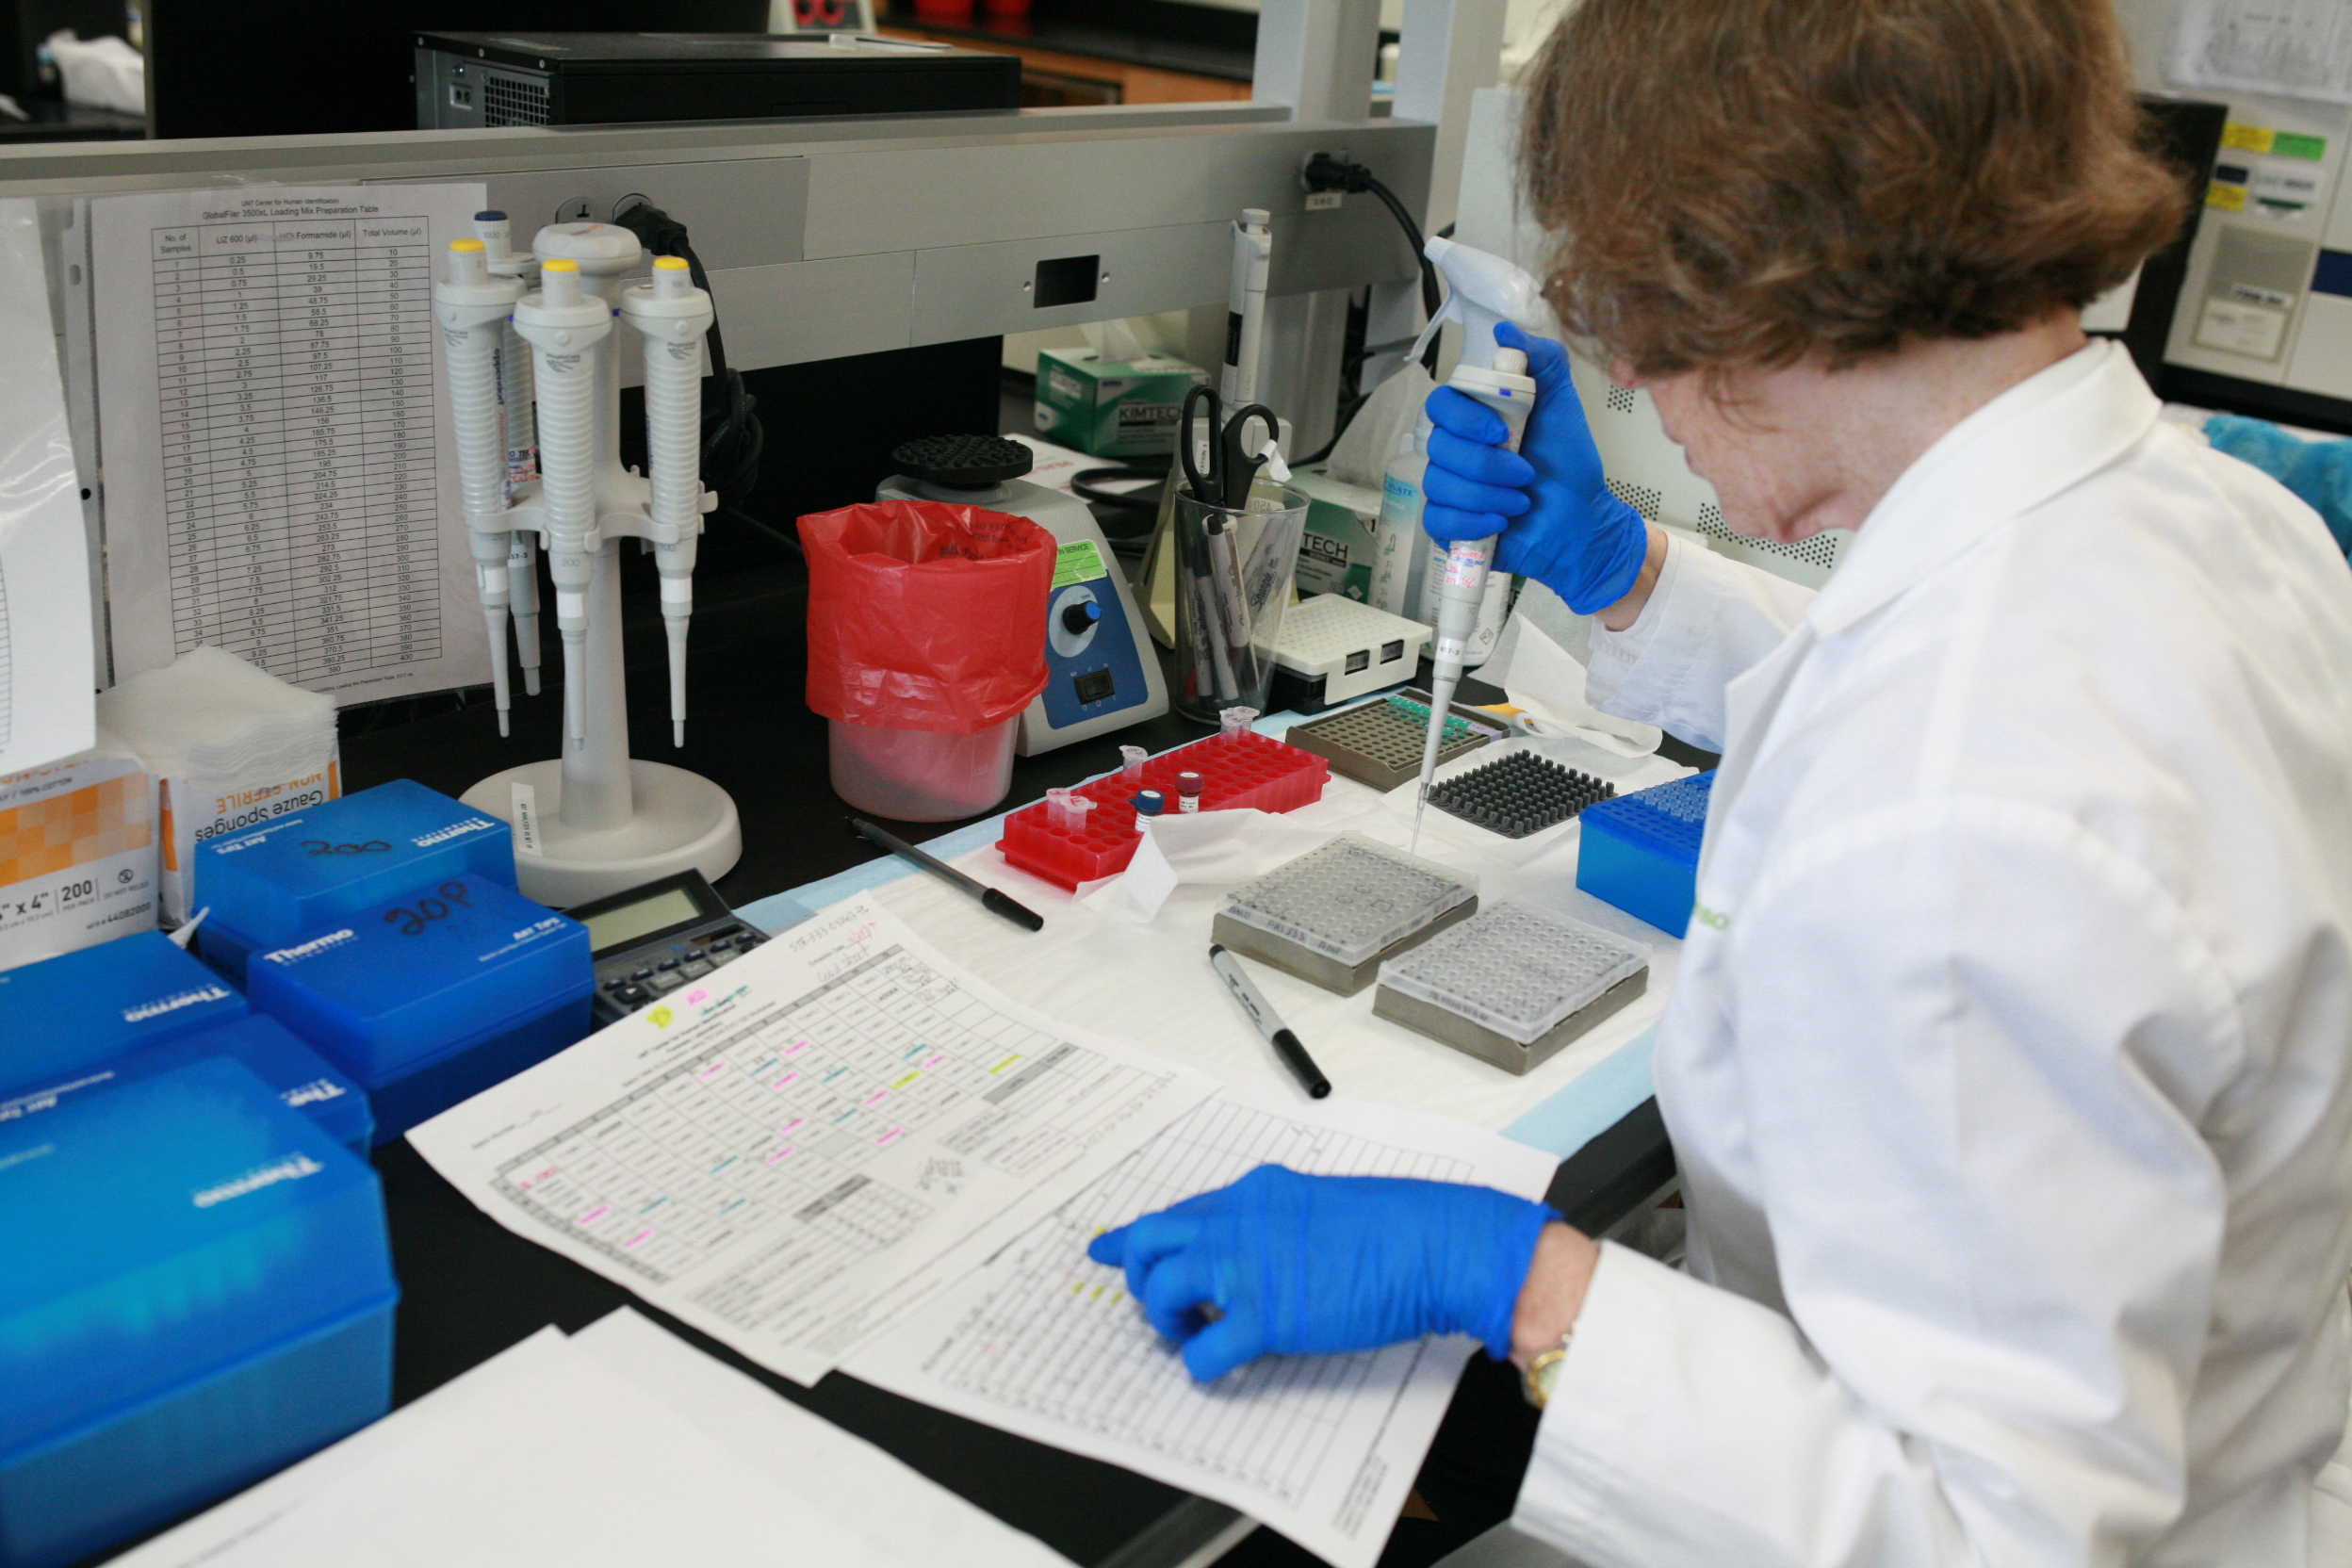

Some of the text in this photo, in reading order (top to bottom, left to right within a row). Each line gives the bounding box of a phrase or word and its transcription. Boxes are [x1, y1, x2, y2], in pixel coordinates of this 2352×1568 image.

[203, 209, 240, 220] GlobalFiler
[270, 207, 300, 217] Loading
[316, 205, 357, 215] Preparation
[230, 235, 243, 243] 600
[296, 231, 337, 239] Formamide
[160, 245, 191, 254] Samples
[231, 255, 245, 265] 0.25
[308, 252, 323, 260] 9.75
[388, 248, 398, 257] 10
[232, 279, 247, 287] 0.75
[389, 270, 398, 279] 30
[233, 302, 248, 311] 1.25
[390, 292, 399, 301] 50
[235, 324, 250, 334] 1.75
[391, 314, 400, 322] 70
[236, 347, 251, 356] 2.25
[391, 335, 400, 344] 90
[237, 369, 252, 379] 2.75
[390, 356, 402, 366] 110
[237, 392, 253, 401] 3.25
[391, 378, 403, 386] 130
[239, 414, 253, 423] 3.75
[391, 399, 404, 408] 150
[240, 435, 254, 445] 4.25
[392, 420, 404, 429] 170
[241, 458, 256, 467] 4.75
[393, 441, 405, 450] 190
[242, 480, 257, 489] 5.25
[393, 462, 406, 471] 210
[243, 500, 258, 511] 5.75
[394, 482, 407, 492] 230
[244, 522, 259, 532] 6.25
[395, 502, 407, 512] 250
[246, 544, 260, 553] 6.75
[396, 523, 408, 532] 270
[1065, 543, 1090, 555] SERVICE
[1302, 531, 1348, 560] TECH
[247, 564, 262, 575] 7.25
[396, 543, 409, 553] 290
[248, 585, 263, 596] 7.75
[397, 564, 410, 573] 310
[250, 607, 264, 616] 8.25
[398, 583, 410, 593] 330
[251, 628, 266, 637] 8.75
[399, 603, 411, 612] 350
[253, 647, 267, 658] 9.25
[399, 623, 412, 632] 370
[400, 643, 413, 652] 390
[273, 790, 323, 815] Gauze
[195, 807, 269, 841] Sponges
[417, 820, 496, 847] Thermo
[300, 840, 392, 856] 200
[61, 879, 92, 902] 200
[263, 928, 353, 964] Thermo
